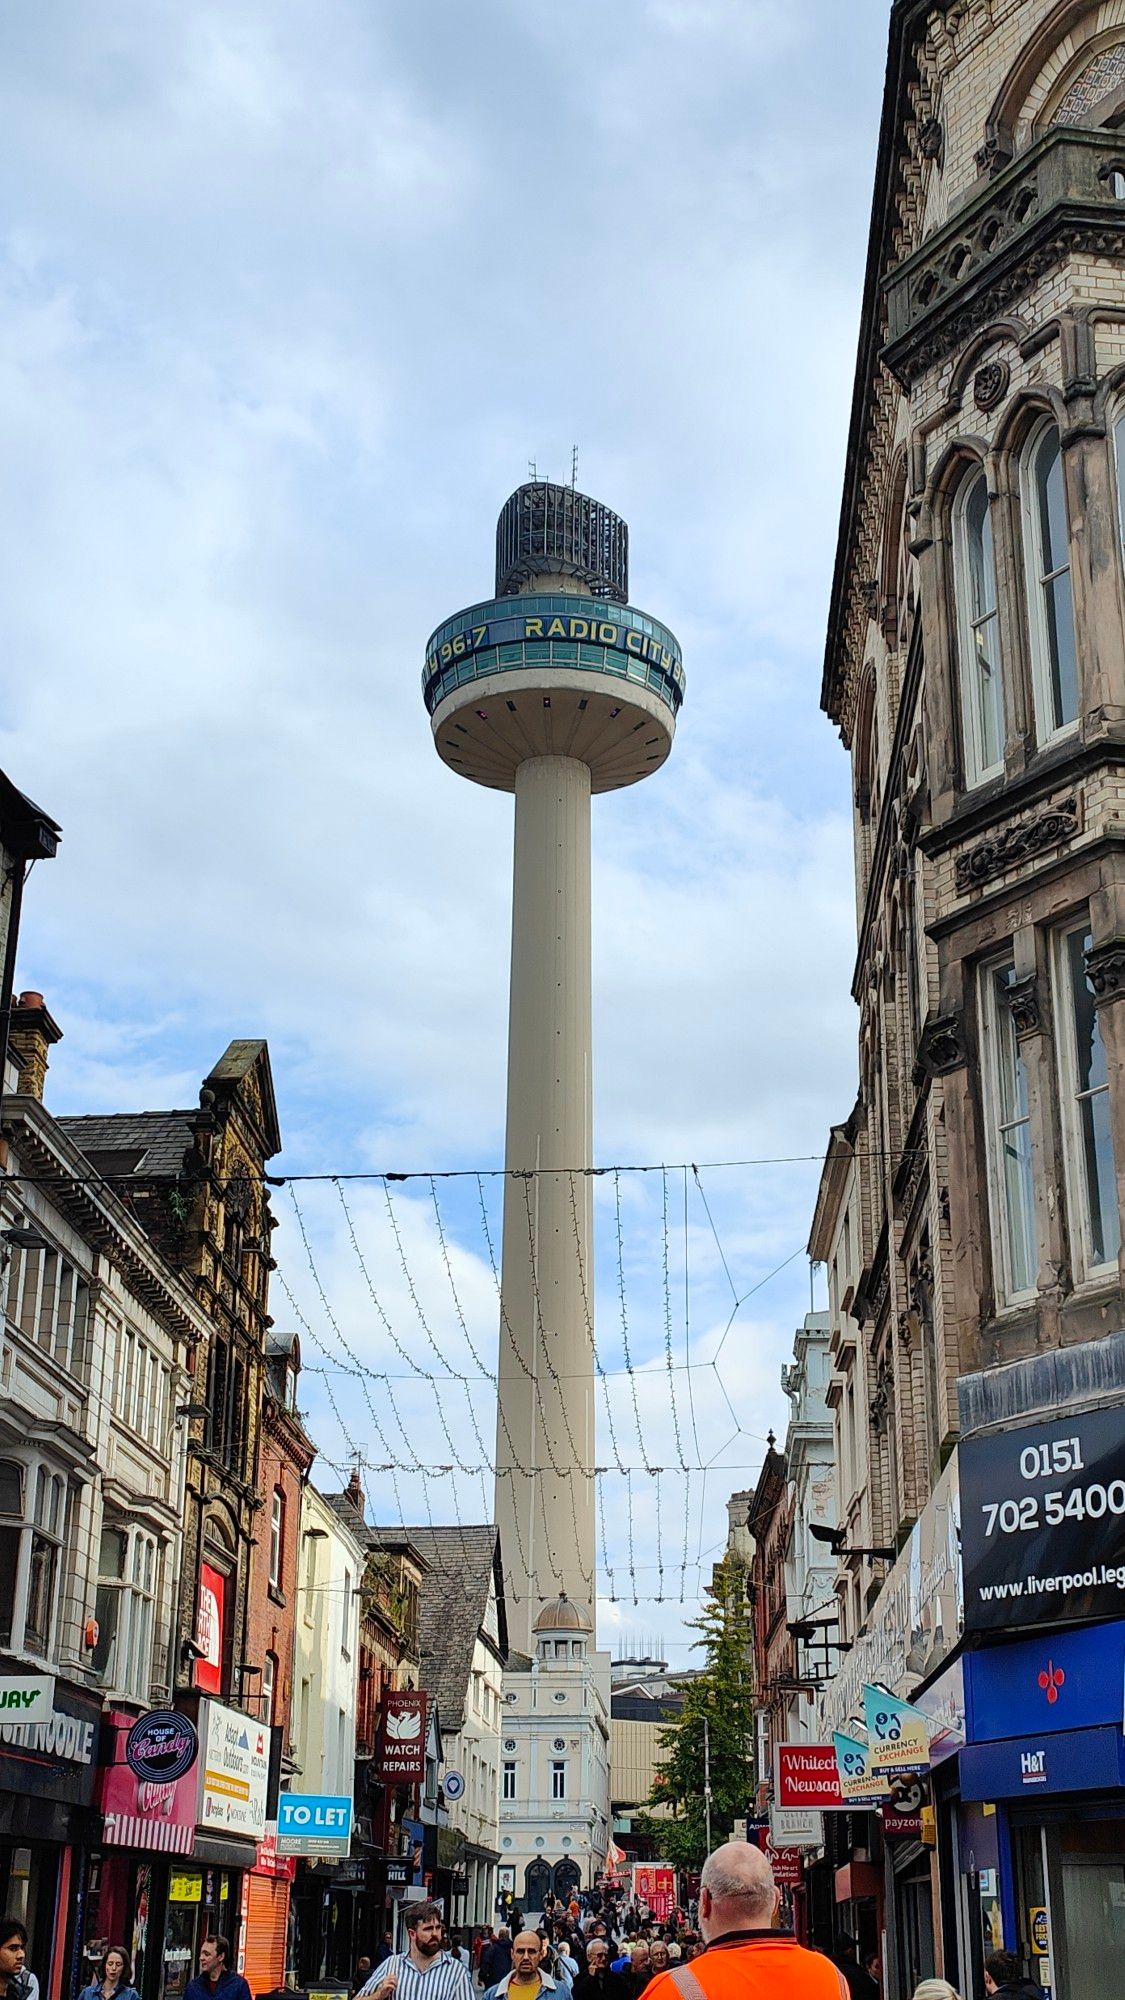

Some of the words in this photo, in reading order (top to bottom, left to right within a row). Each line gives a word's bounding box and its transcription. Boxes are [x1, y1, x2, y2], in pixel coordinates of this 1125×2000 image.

[525, 618, 618, 644] RADIO
[626, 631, 672, 669] CITY
[1020, 1437, 1084, 1479] 0151
[982, 1497, 1039, 1536] 702
[1045, 1480, 1125, 1525] 5400
[147, 1728, 175, 1736] HOUSE
[130, 1732, 191, 1761] Candy
[384, 1745, 421, 1755] WATCH
[874, 1738, 919, 1755] CURRENCY
[879, 1746, 925, 1763] EXCHANGE
[382, 1761, 421, 1772] REPAIRS
[782, 1754, 838, 1771] Whitech
[1021, 1751, 1046, 1773] H&T
[784, 1776, 840, 1797] Newsag
[843, 1775, 879, 1788] CURRENCY
[847, 1779, 885, 1794] EXCHANGE
[283, 1805, 311, 1825] TO
[314, 1806, 347, 1827] LET
[885, 1819, 923, 1828] payzon
[388, 1871, 406, 1881] HILL
